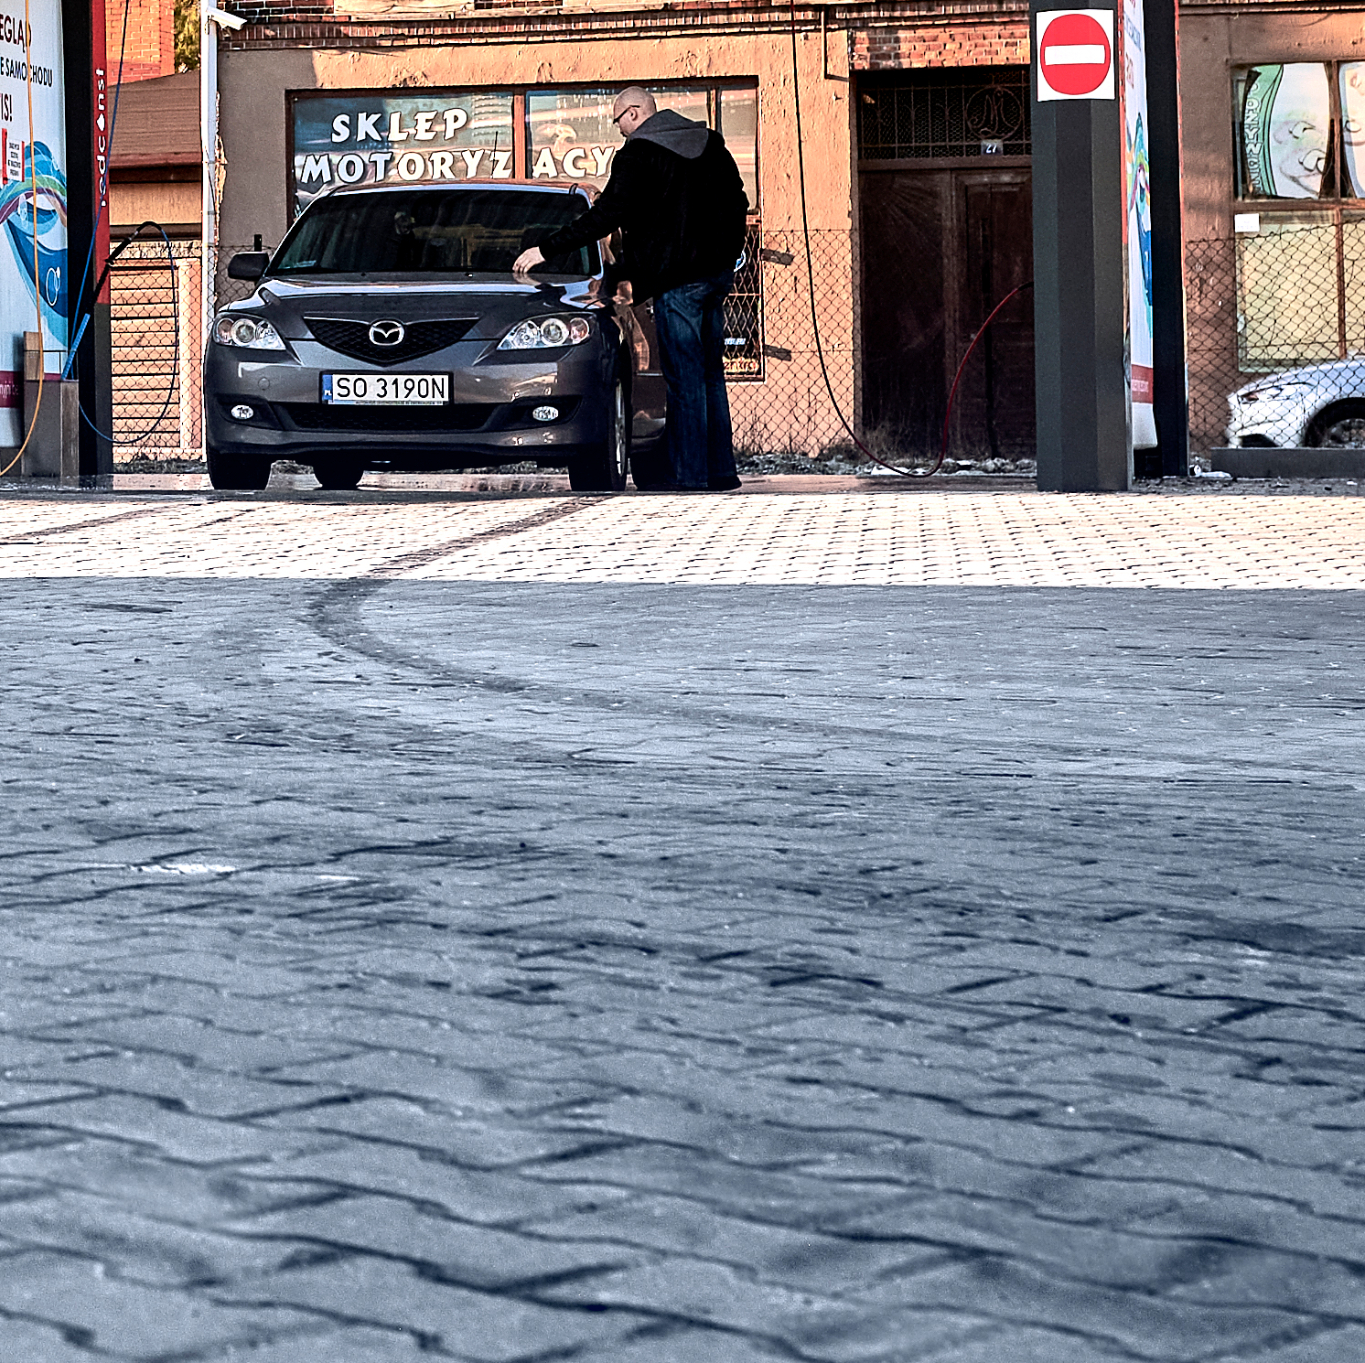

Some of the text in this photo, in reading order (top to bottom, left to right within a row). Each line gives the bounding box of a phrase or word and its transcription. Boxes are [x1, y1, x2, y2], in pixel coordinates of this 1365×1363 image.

[331, 108, 467, 143] SKLEP
[337, 378, 445, 399] SO 3190N
